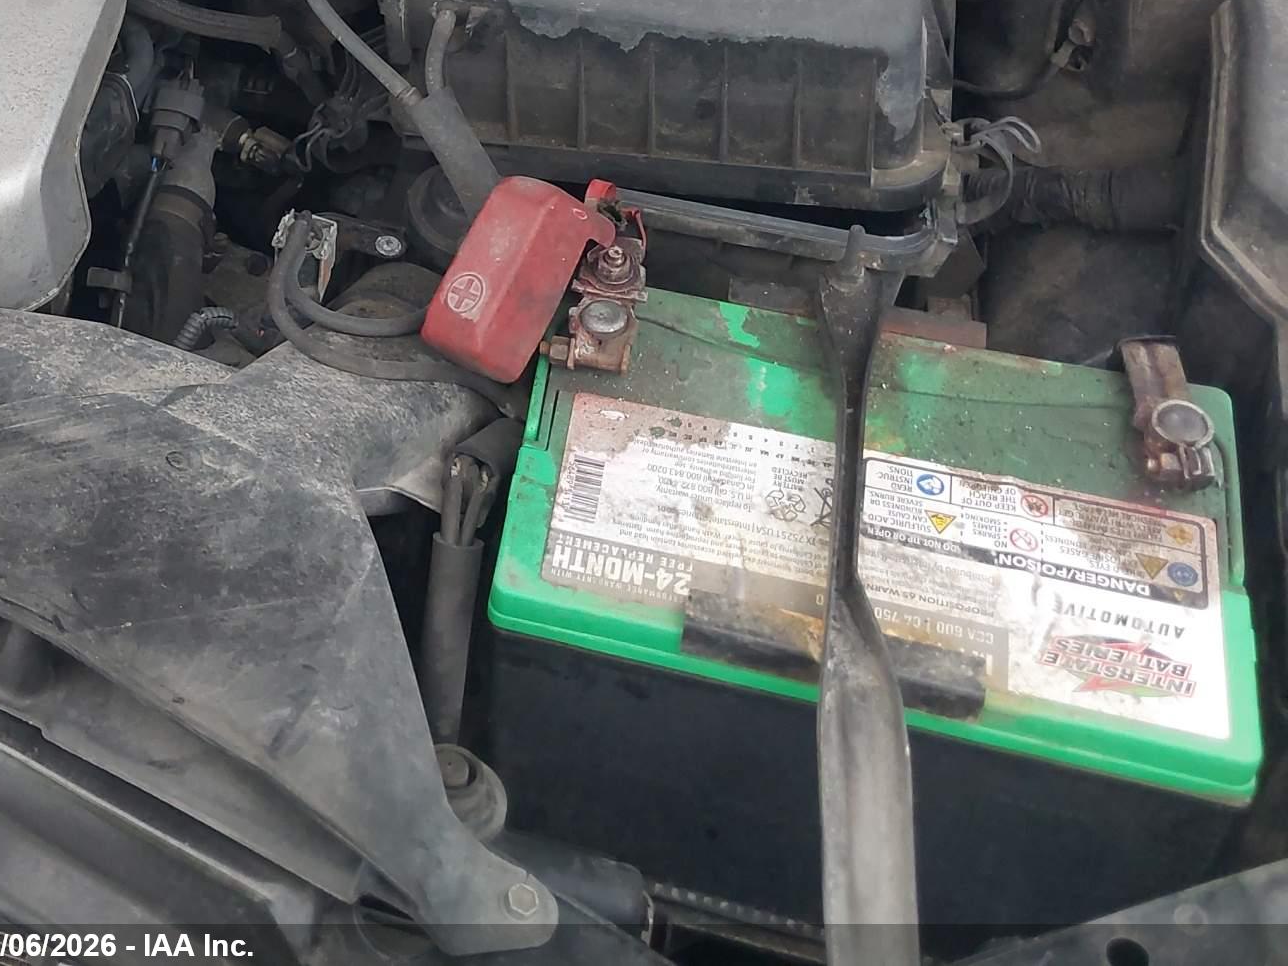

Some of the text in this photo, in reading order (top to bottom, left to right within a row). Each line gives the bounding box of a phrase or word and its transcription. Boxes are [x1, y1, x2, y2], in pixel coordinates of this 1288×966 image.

[745, 475, 756, 483] For
[772, 467, 808, 479] RECYCLED
[774, 480, 804, 492] BATTERY
[785, 476, 804, 485] MUST
[715, 486, 728, 497] call
[747, 484, 755, 492] in
[891, 483, 913, 493] READ
[1005, 488, 1016, 496] OF
[656, 485, 752, 514] To replace under warranty,
[730, 490, 744, 499] U.S.
[745, 493, 752, 501] in
[970, 491, 1016, 504] THE REACH
[870, 499, 923, 515] BLINDNESS OR
[897, 497, 923, 508] SEVERE
[962, 497, 1016, 513] KEEP OUT OF
[888, 510, 928, 524] CAN CAUSE
[966, 513, 1001, 525] SMOKING
[868, 514, 931, 534] SULFURIC ACID
[973, 522, 1001, 533] FLAMES
[757, 526, 774, 537] USA
[777, 530, 805, 544] 75251
[973, 529, 1001, 540] SPARKS
[868, 527, 956, 552] DO NOT TIP OR OPEN
[995, 540, 1008, 549] NO
[556, 534, 693, 573] FREE REPLACEMENT
[552, 544, 692, 597] 24-MONTH
[874, 607, 898, 624] 750
[1052, 597, 1185, 640] AUTOMOTIVE
[968, 629, 994, 645] CCA
[1057, 639, 1187, 678] BATTERIES
[1045, 651, 1192, 695] INTERSTATE
